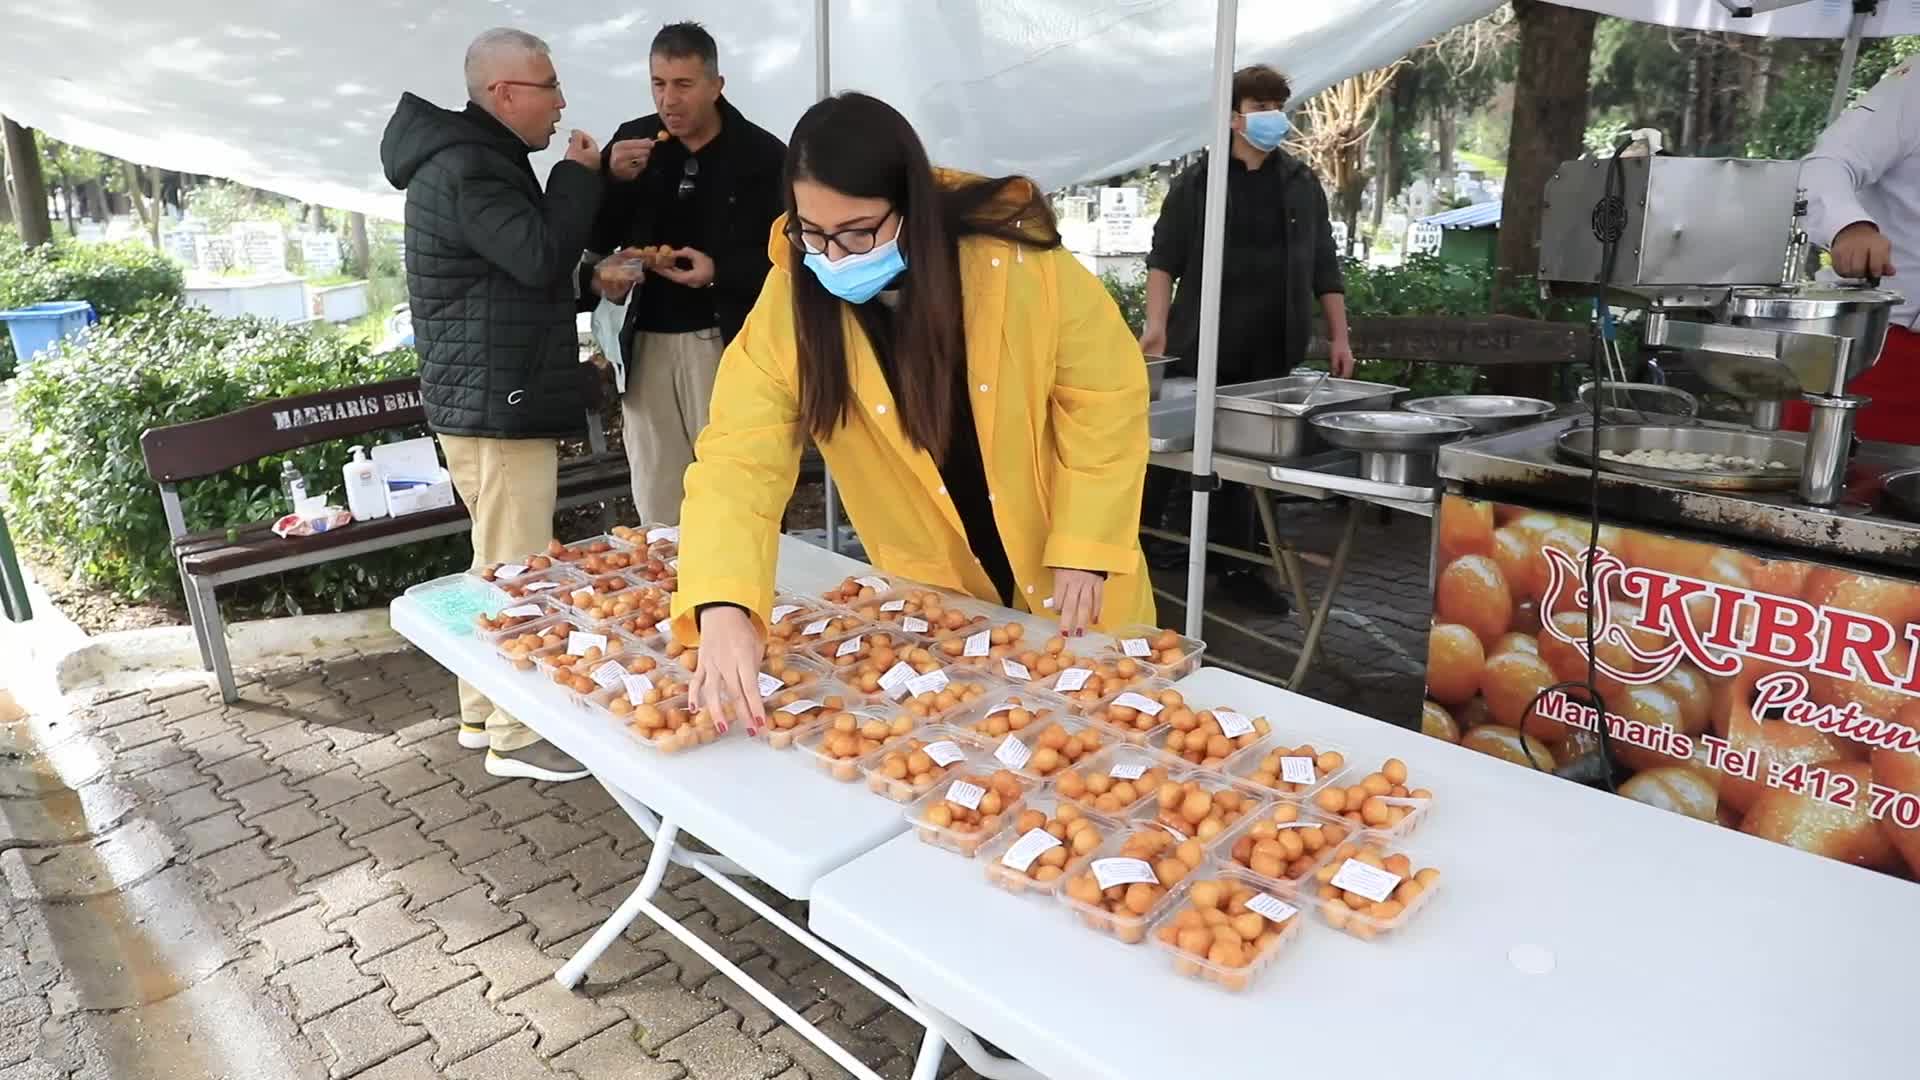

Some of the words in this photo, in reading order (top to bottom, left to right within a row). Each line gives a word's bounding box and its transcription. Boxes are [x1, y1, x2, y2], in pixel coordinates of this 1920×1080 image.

[272, 395, 380, 430] MARMARİS
[1536, 687, 1694, 760] Marmaris
[1700, 733, 1761, 781] Tel
[1868, 783, 1920, 829] 70
